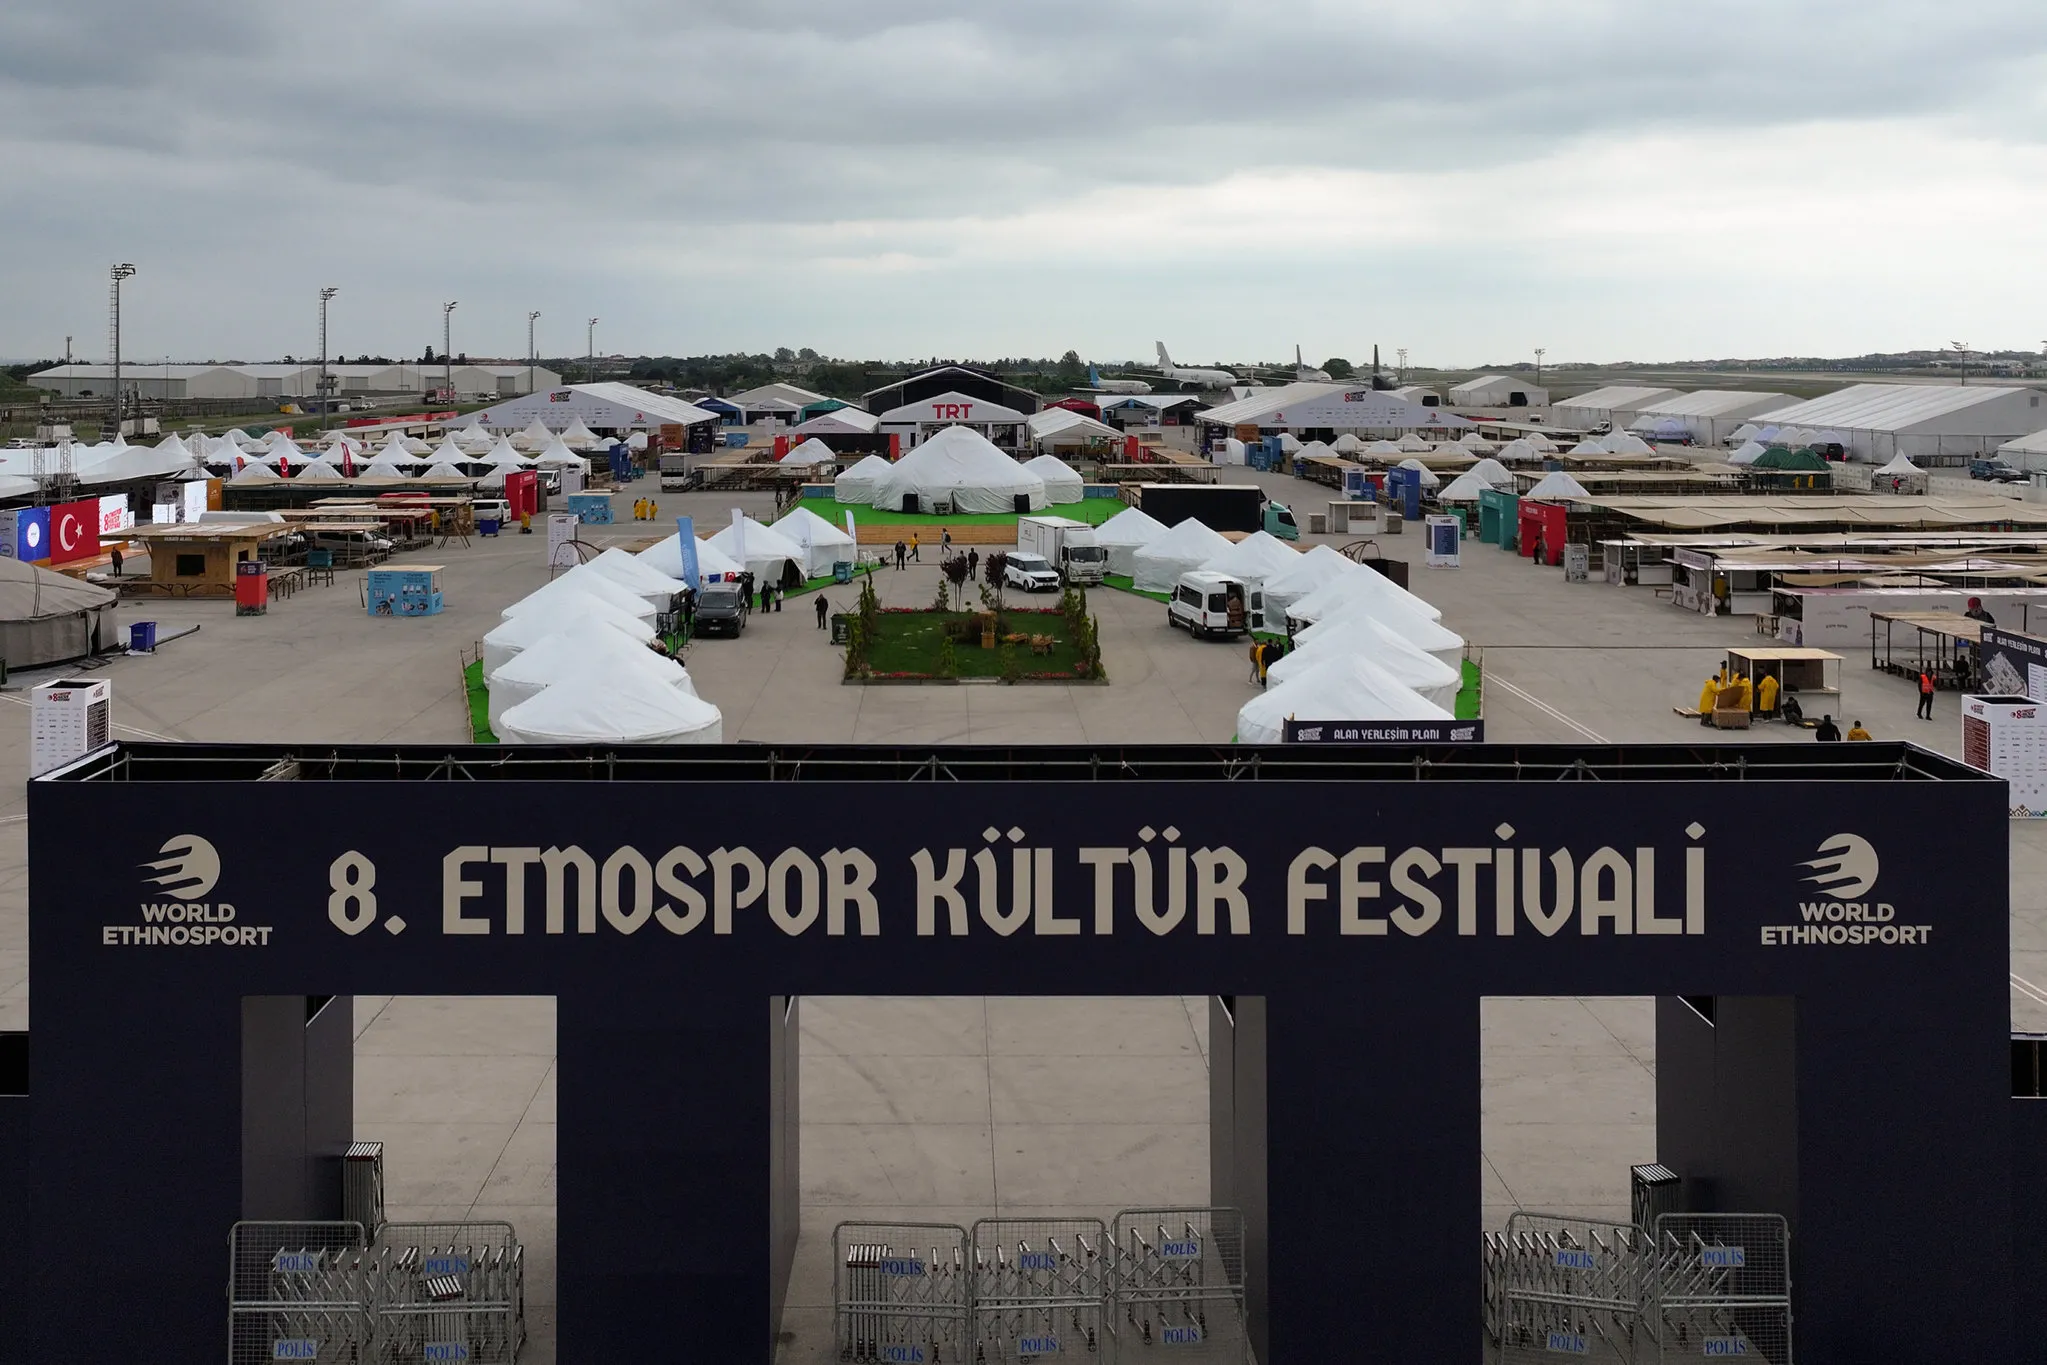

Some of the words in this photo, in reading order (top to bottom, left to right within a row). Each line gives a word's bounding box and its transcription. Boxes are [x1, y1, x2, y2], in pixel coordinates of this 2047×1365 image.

[932, 404, 973, 419] TRT
[1334, 729, 1358, 740] ALAN
[1361, 726, 1409, 741] YERLEŞİM
[1412, 729, 1439, 740] PLANI
[329, 850, 406, 935] 8.
[443, 845, 880, 936] ETNOSPOR
[910, 825, 1251, 936] KÜLTÜR
[1287, 821, 1706, 937] FESTİVALİ
[141, 904, 235, 922] WORLD
[1799, 903, 1895, 921] WORLD
[103, 926, 272, 945] ETHNOSPORT
[1761, 925, 1932, 945] ETHNOSPORT
[1163, 1239, 1198, 1256] POLİS
[1703, 1247, 1744, 1265] POLİS
[279, 1253, 314, 1271] POLİS
[881, 1258, 923, 1276] POLİS
[1020, 1251, 1056, 1270] POLİS
[1557, 1250, 1594, 1268] POLİS
[1163, 1326, 1198, 1343] POLİS
[1549, 1333, 1585, 1352] POLİS
[277, 1340, 313, 1357] POLİS
[1020, 1336, 1057, 1353] POLİS
[1705, 1337, 1746, 1355] POLİS
